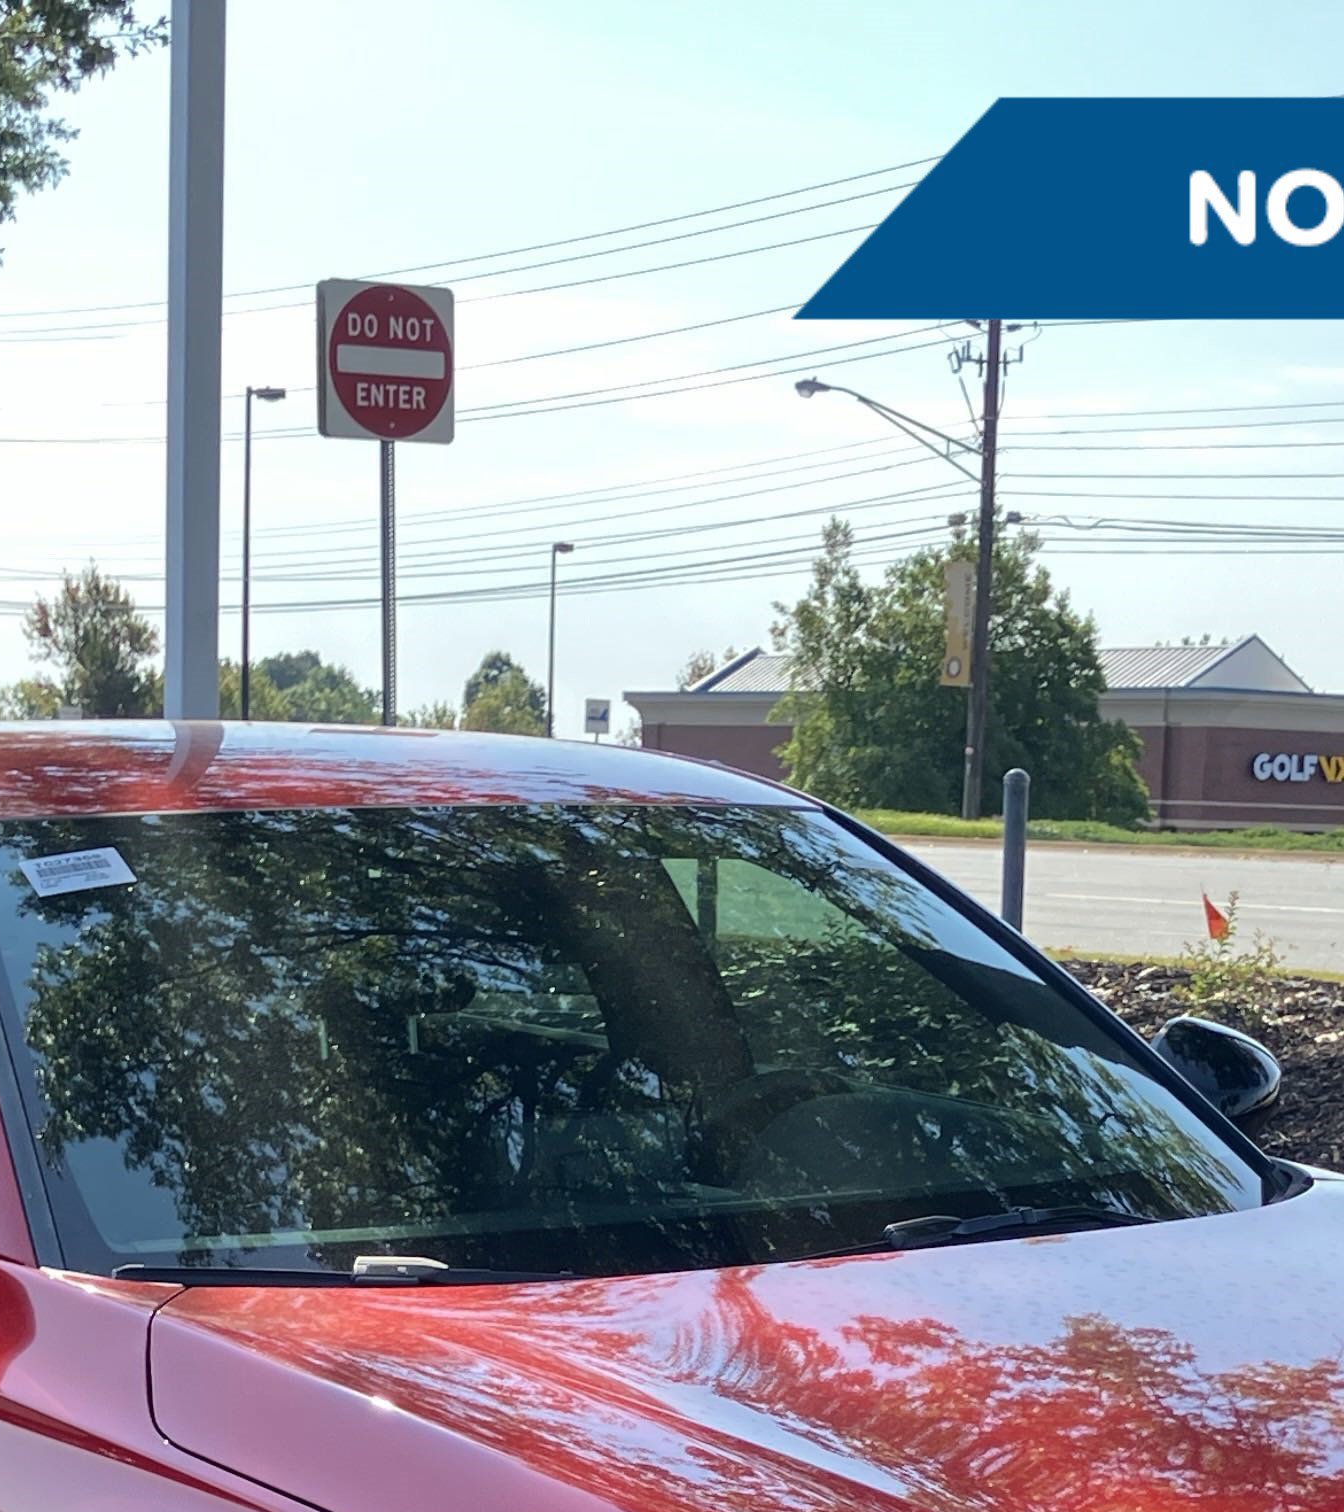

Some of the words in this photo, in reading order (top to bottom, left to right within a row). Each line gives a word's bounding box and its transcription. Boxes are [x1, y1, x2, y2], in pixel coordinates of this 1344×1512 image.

[347, 312, 378, 338] DO
[389, 316, 434, 342] NOT
[356, 382, 426, 410] ENTER
[1253, 753, 1318, 782] GOLF
